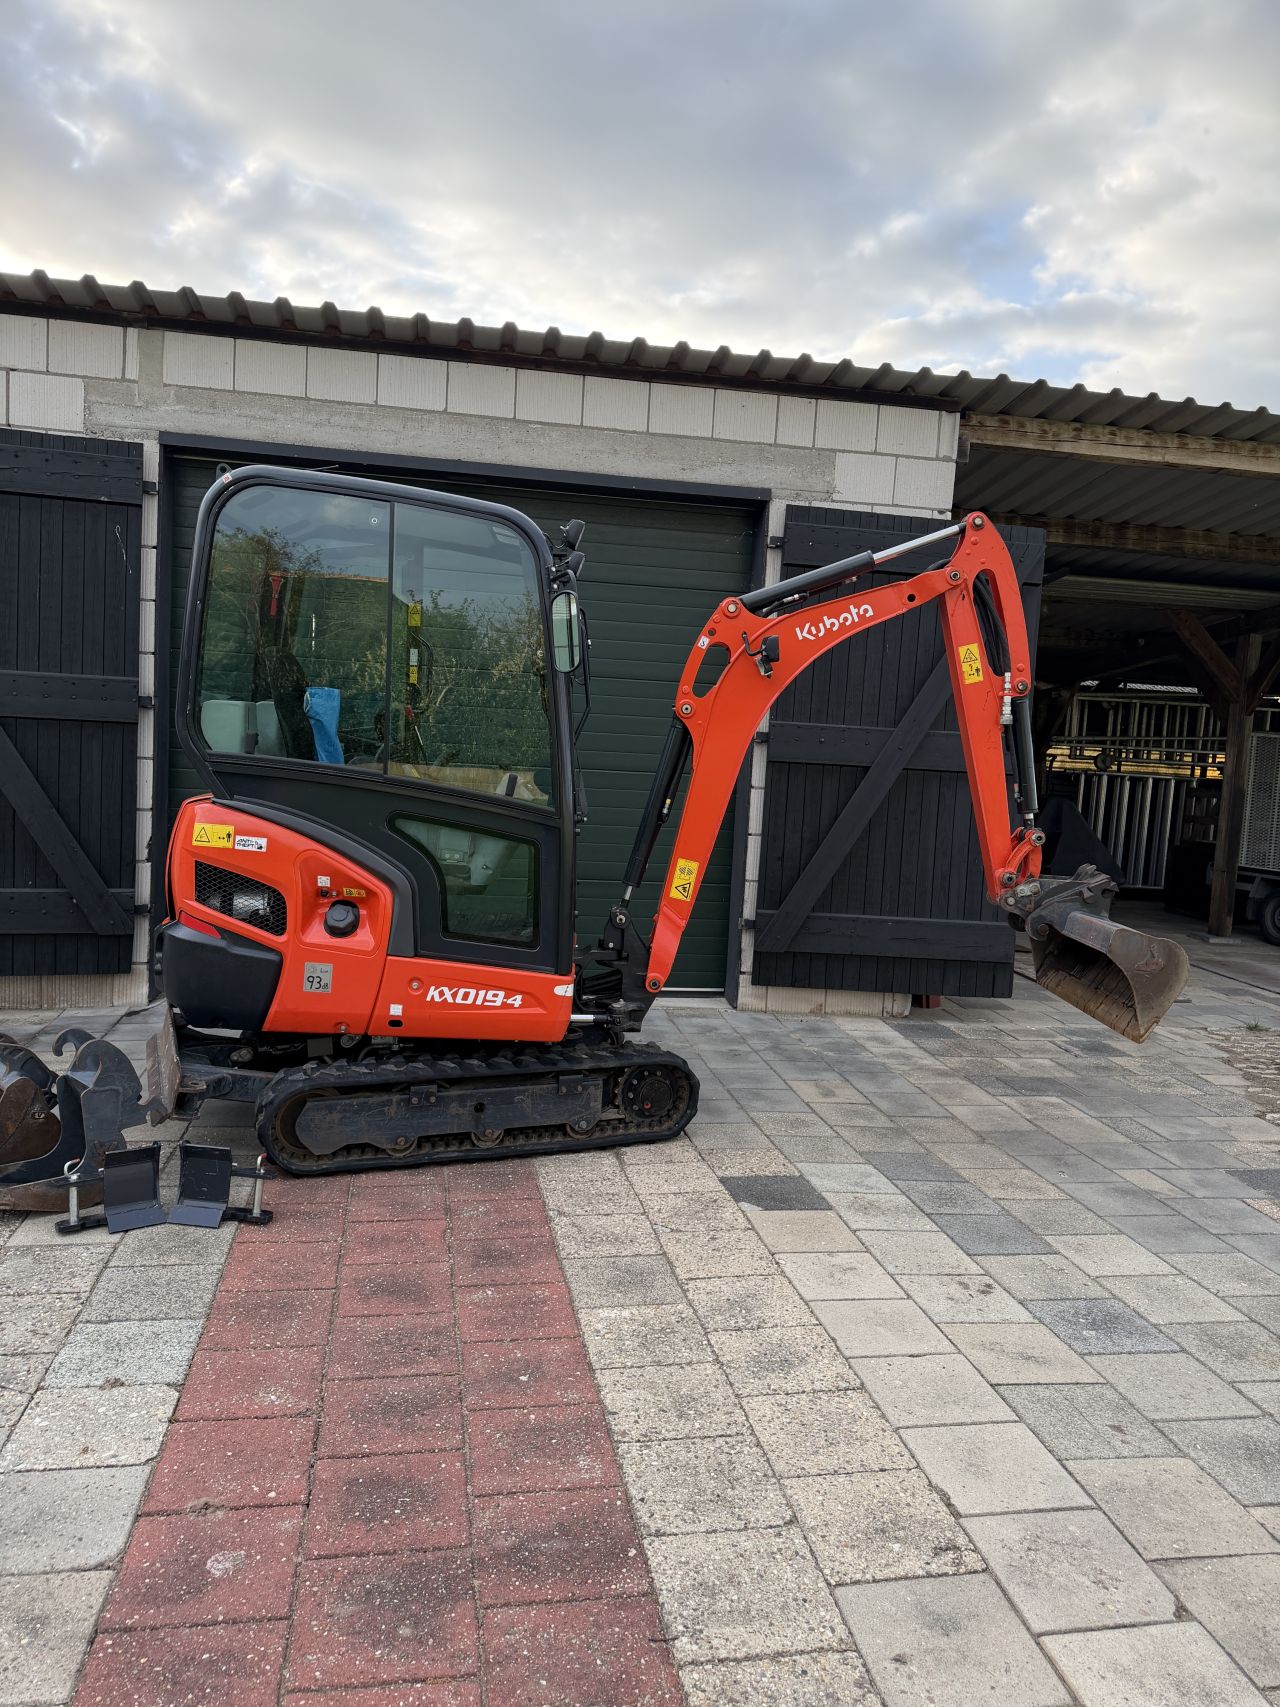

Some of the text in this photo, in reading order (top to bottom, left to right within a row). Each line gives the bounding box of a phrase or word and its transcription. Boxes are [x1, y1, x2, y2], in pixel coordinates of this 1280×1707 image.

[795, 604, 874, 640] Kubota
[307, 975, 322, 989] 93
[426, 985, 523, 1007] KX019-4
